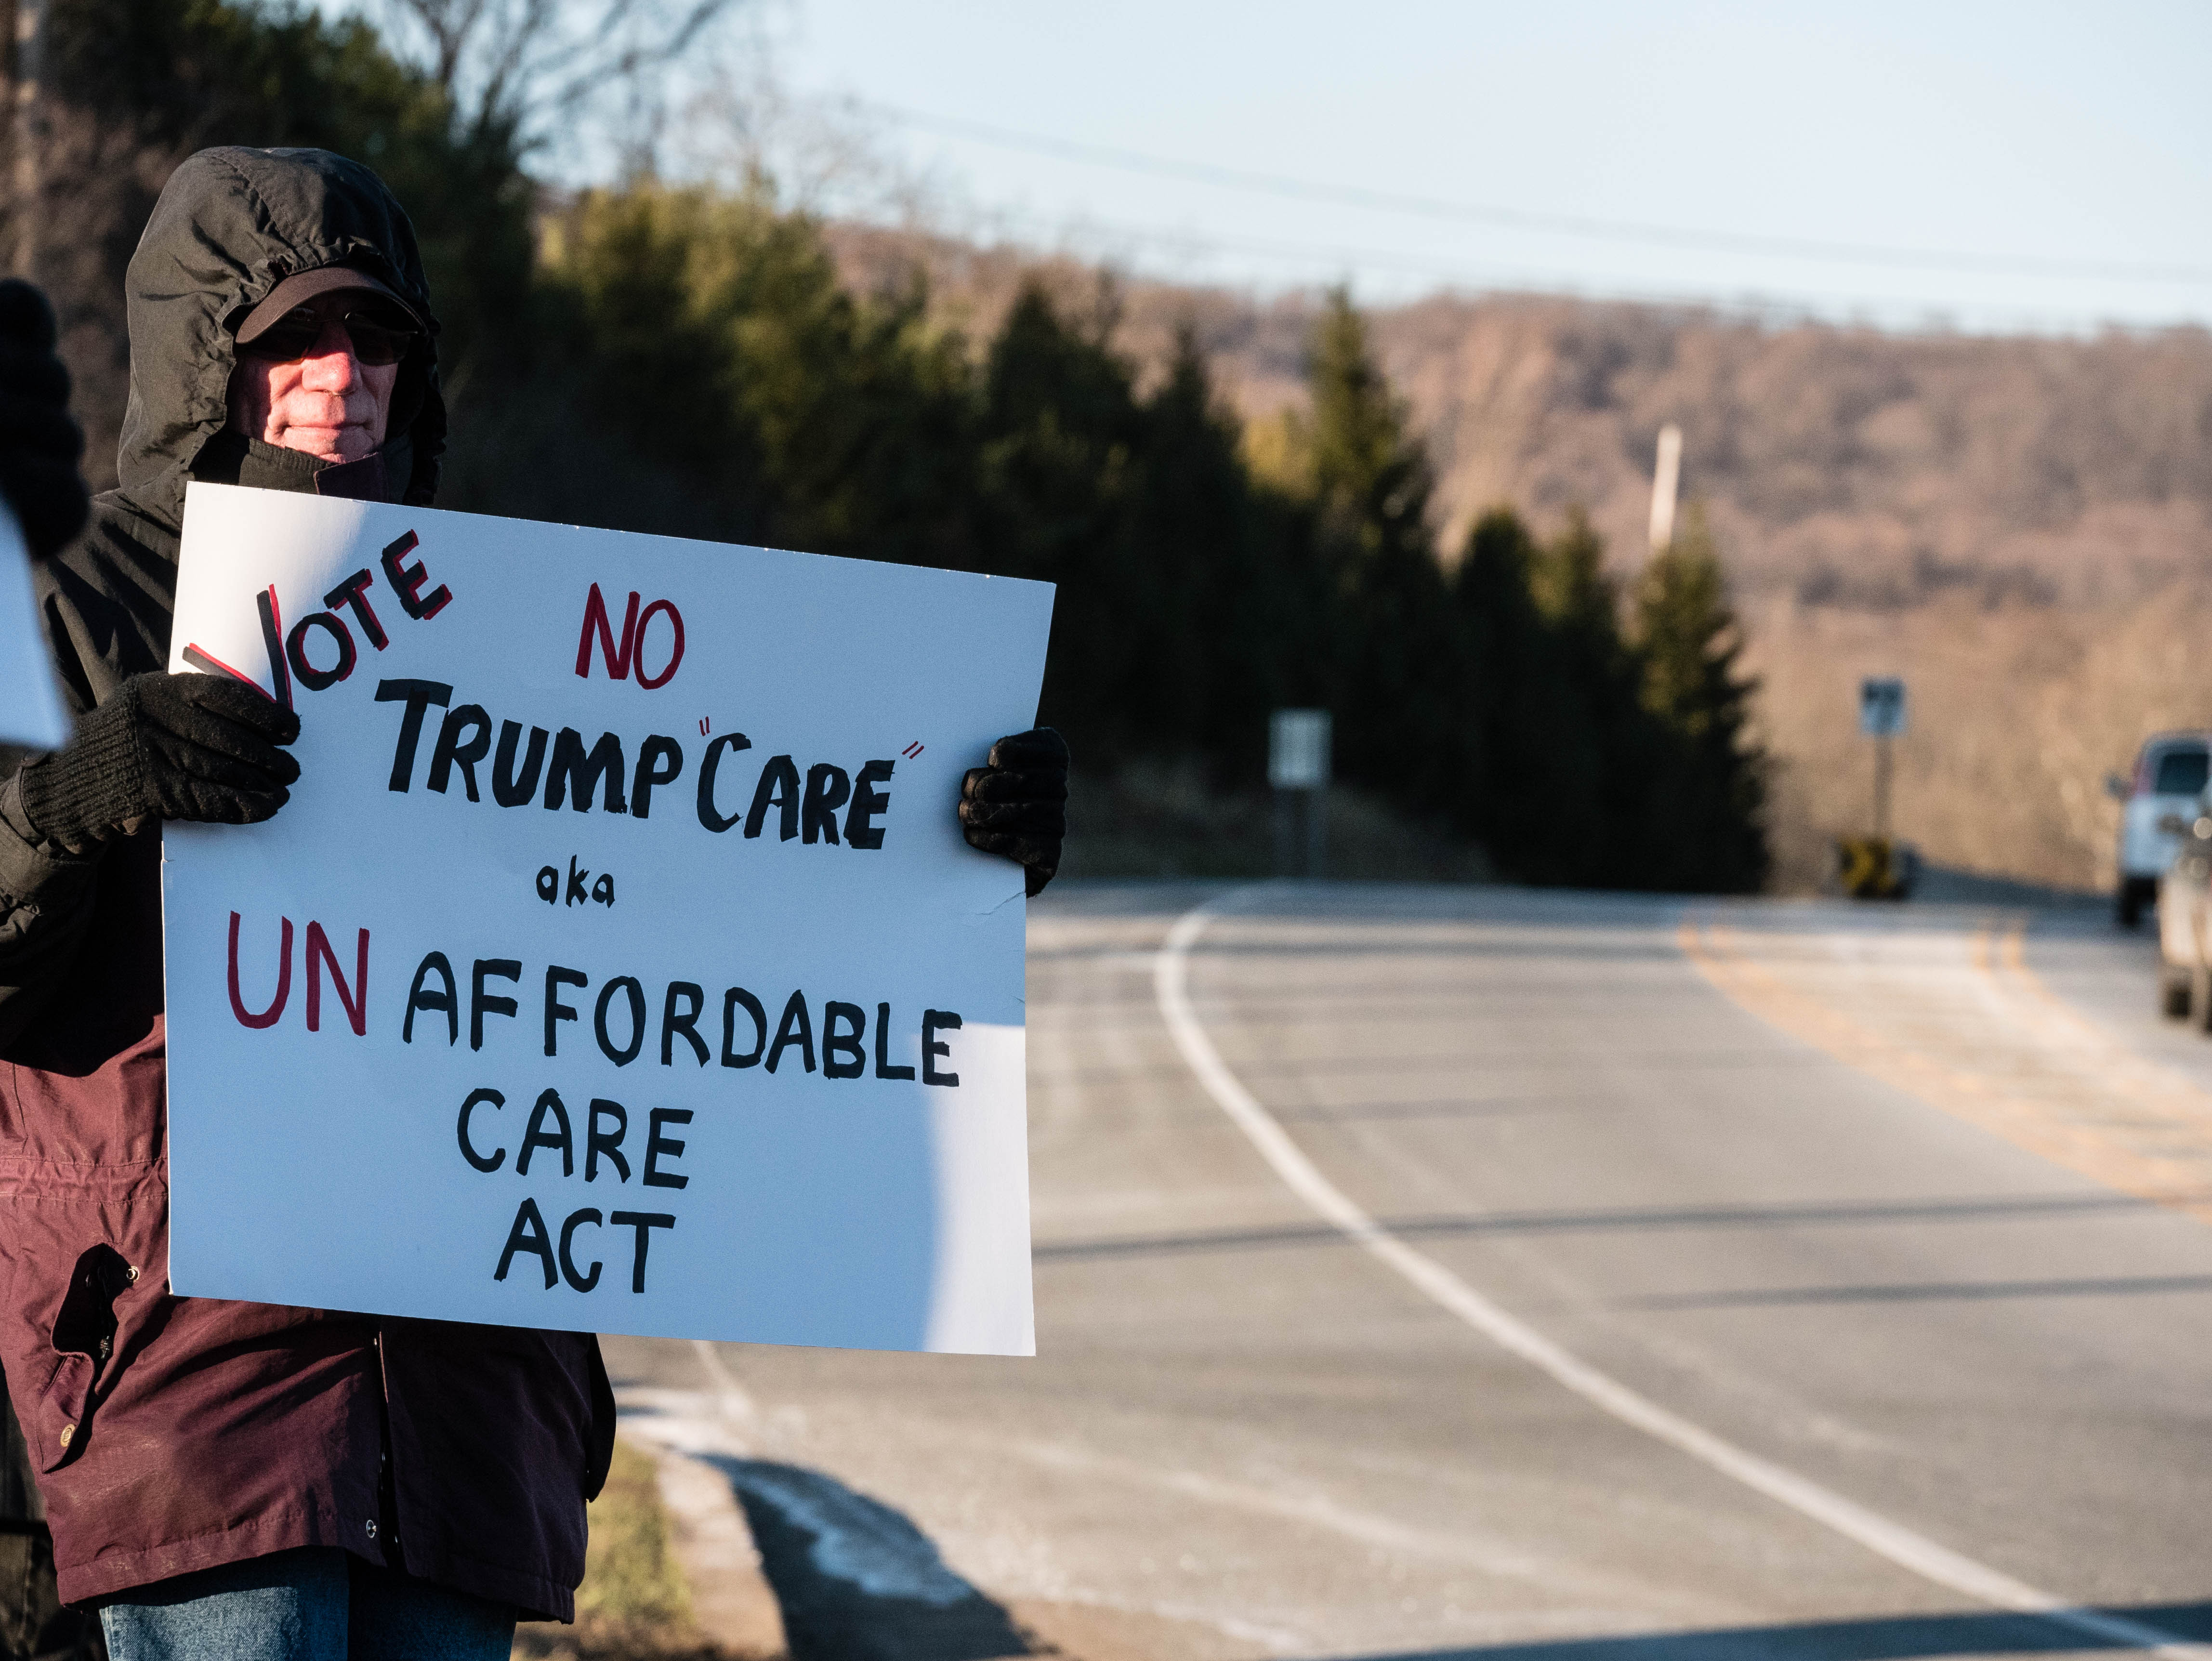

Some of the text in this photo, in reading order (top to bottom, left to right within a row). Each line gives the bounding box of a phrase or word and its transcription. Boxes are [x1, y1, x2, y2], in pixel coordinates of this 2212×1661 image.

[182, 529, 685, 710] VOTE NO
[374, 679, 684, 819] TRUMP
[536, 855, 616, 909] aka
[227, 911, 963, 1087] UN AFFORDABLE
[457, 1088, 694, 1190] CARE
[494, 1198, 676, 1294] ACT
